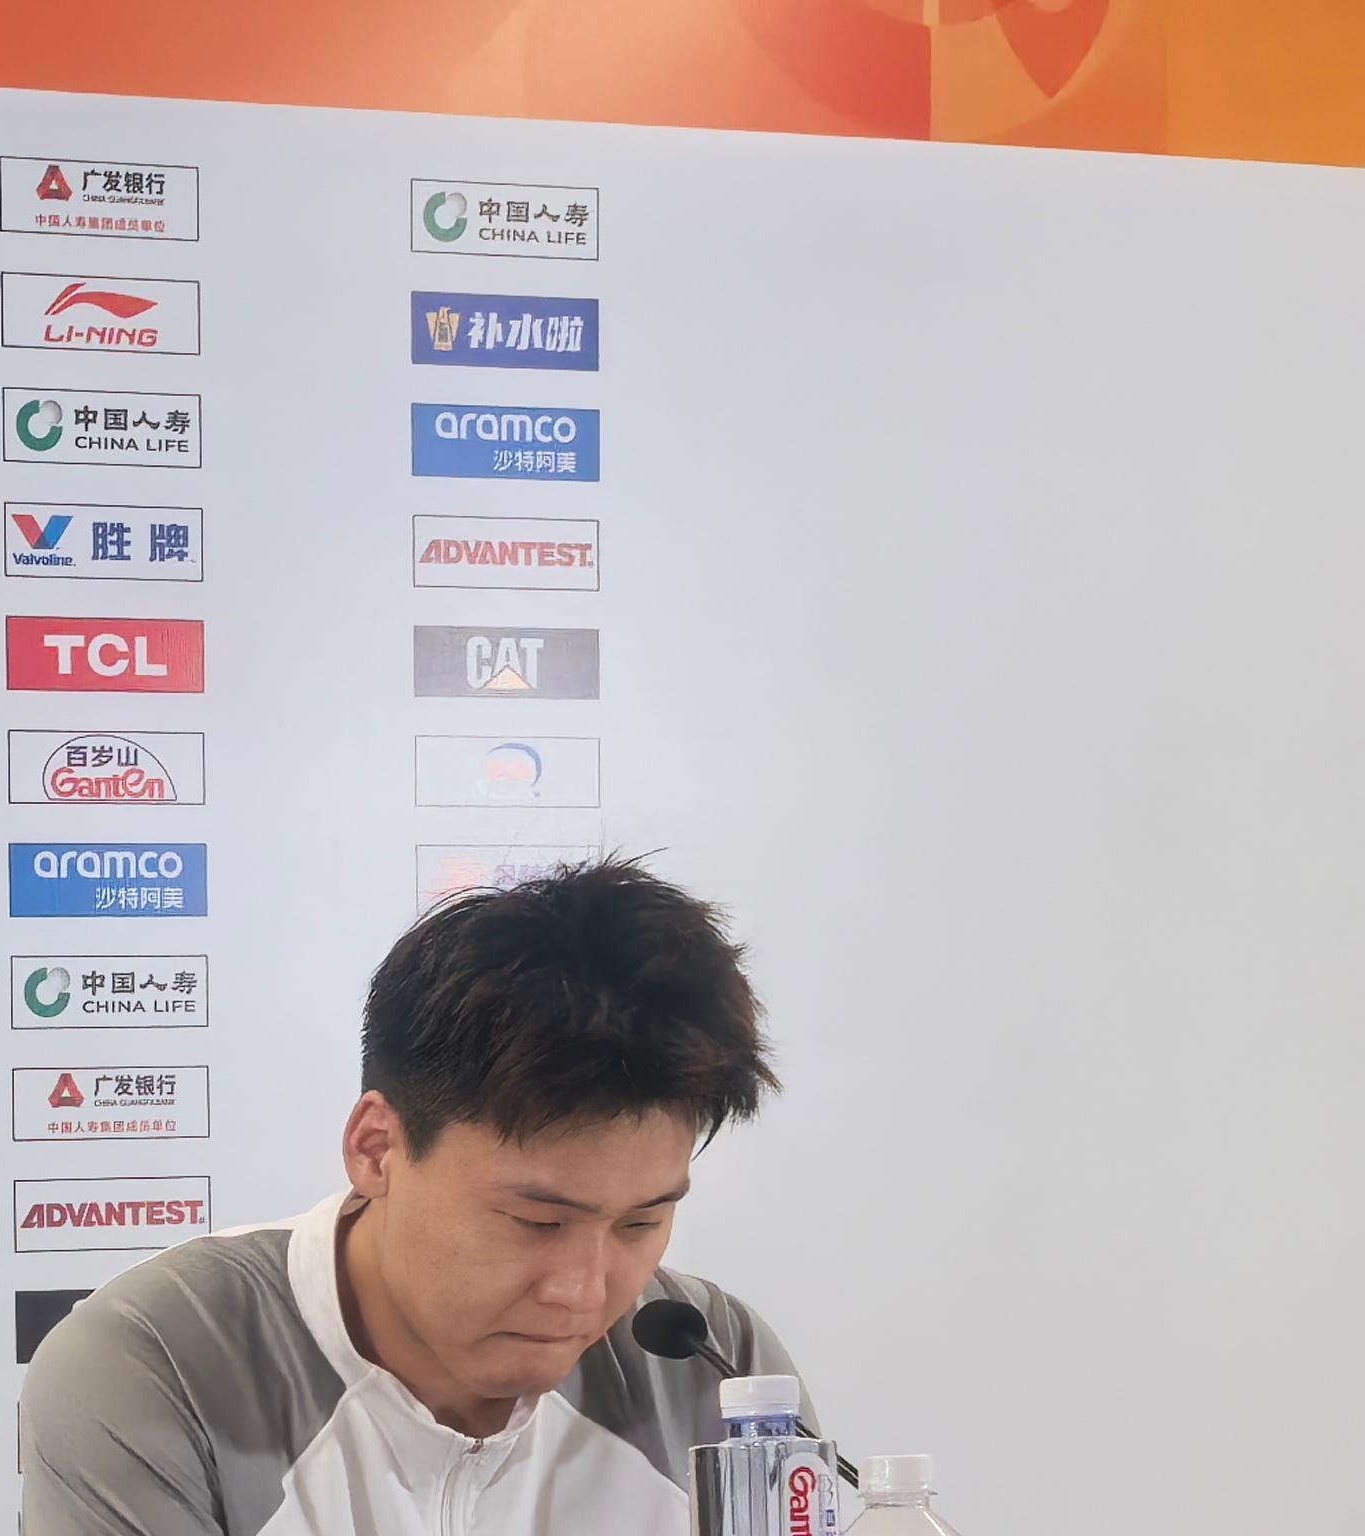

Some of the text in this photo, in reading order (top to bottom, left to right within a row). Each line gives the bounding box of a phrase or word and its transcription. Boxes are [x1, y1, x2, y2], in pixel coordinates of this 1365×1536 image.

[81, 168, 165, 196] 广发银行
[478, 197, 589, 228] 中国人寿
[478, 227, 587, 246] CHINA LIFE
[43, 324, 159, 347] LI-NING
[467, 311, 584, 353] 补水啦
[73, 405, 191, 435] 中国人寿
[434, 411, 576, 443] aramco
[74, 435, 189, 453] CHINA LIFE
[491, 449, 577, 474] 沙特阿美
[417, 536, 592, 567] ADVANTEST
[43, 631, 168, 676] TCL
[466, 636, 544, 689] CAT
[66, 745, 139, 768] 百岁山
[32, 850, 182, 878] aramco
[93, 887, 183, 909] 沙特阿美
[81, 970, 197, 996] 中国人寿
[82, 1000, 195, 1013] CHINA LIFE
[93, 1073, 175, 1097] 广发银行
[19, 1198, 203, 1227] ADVANTEST
